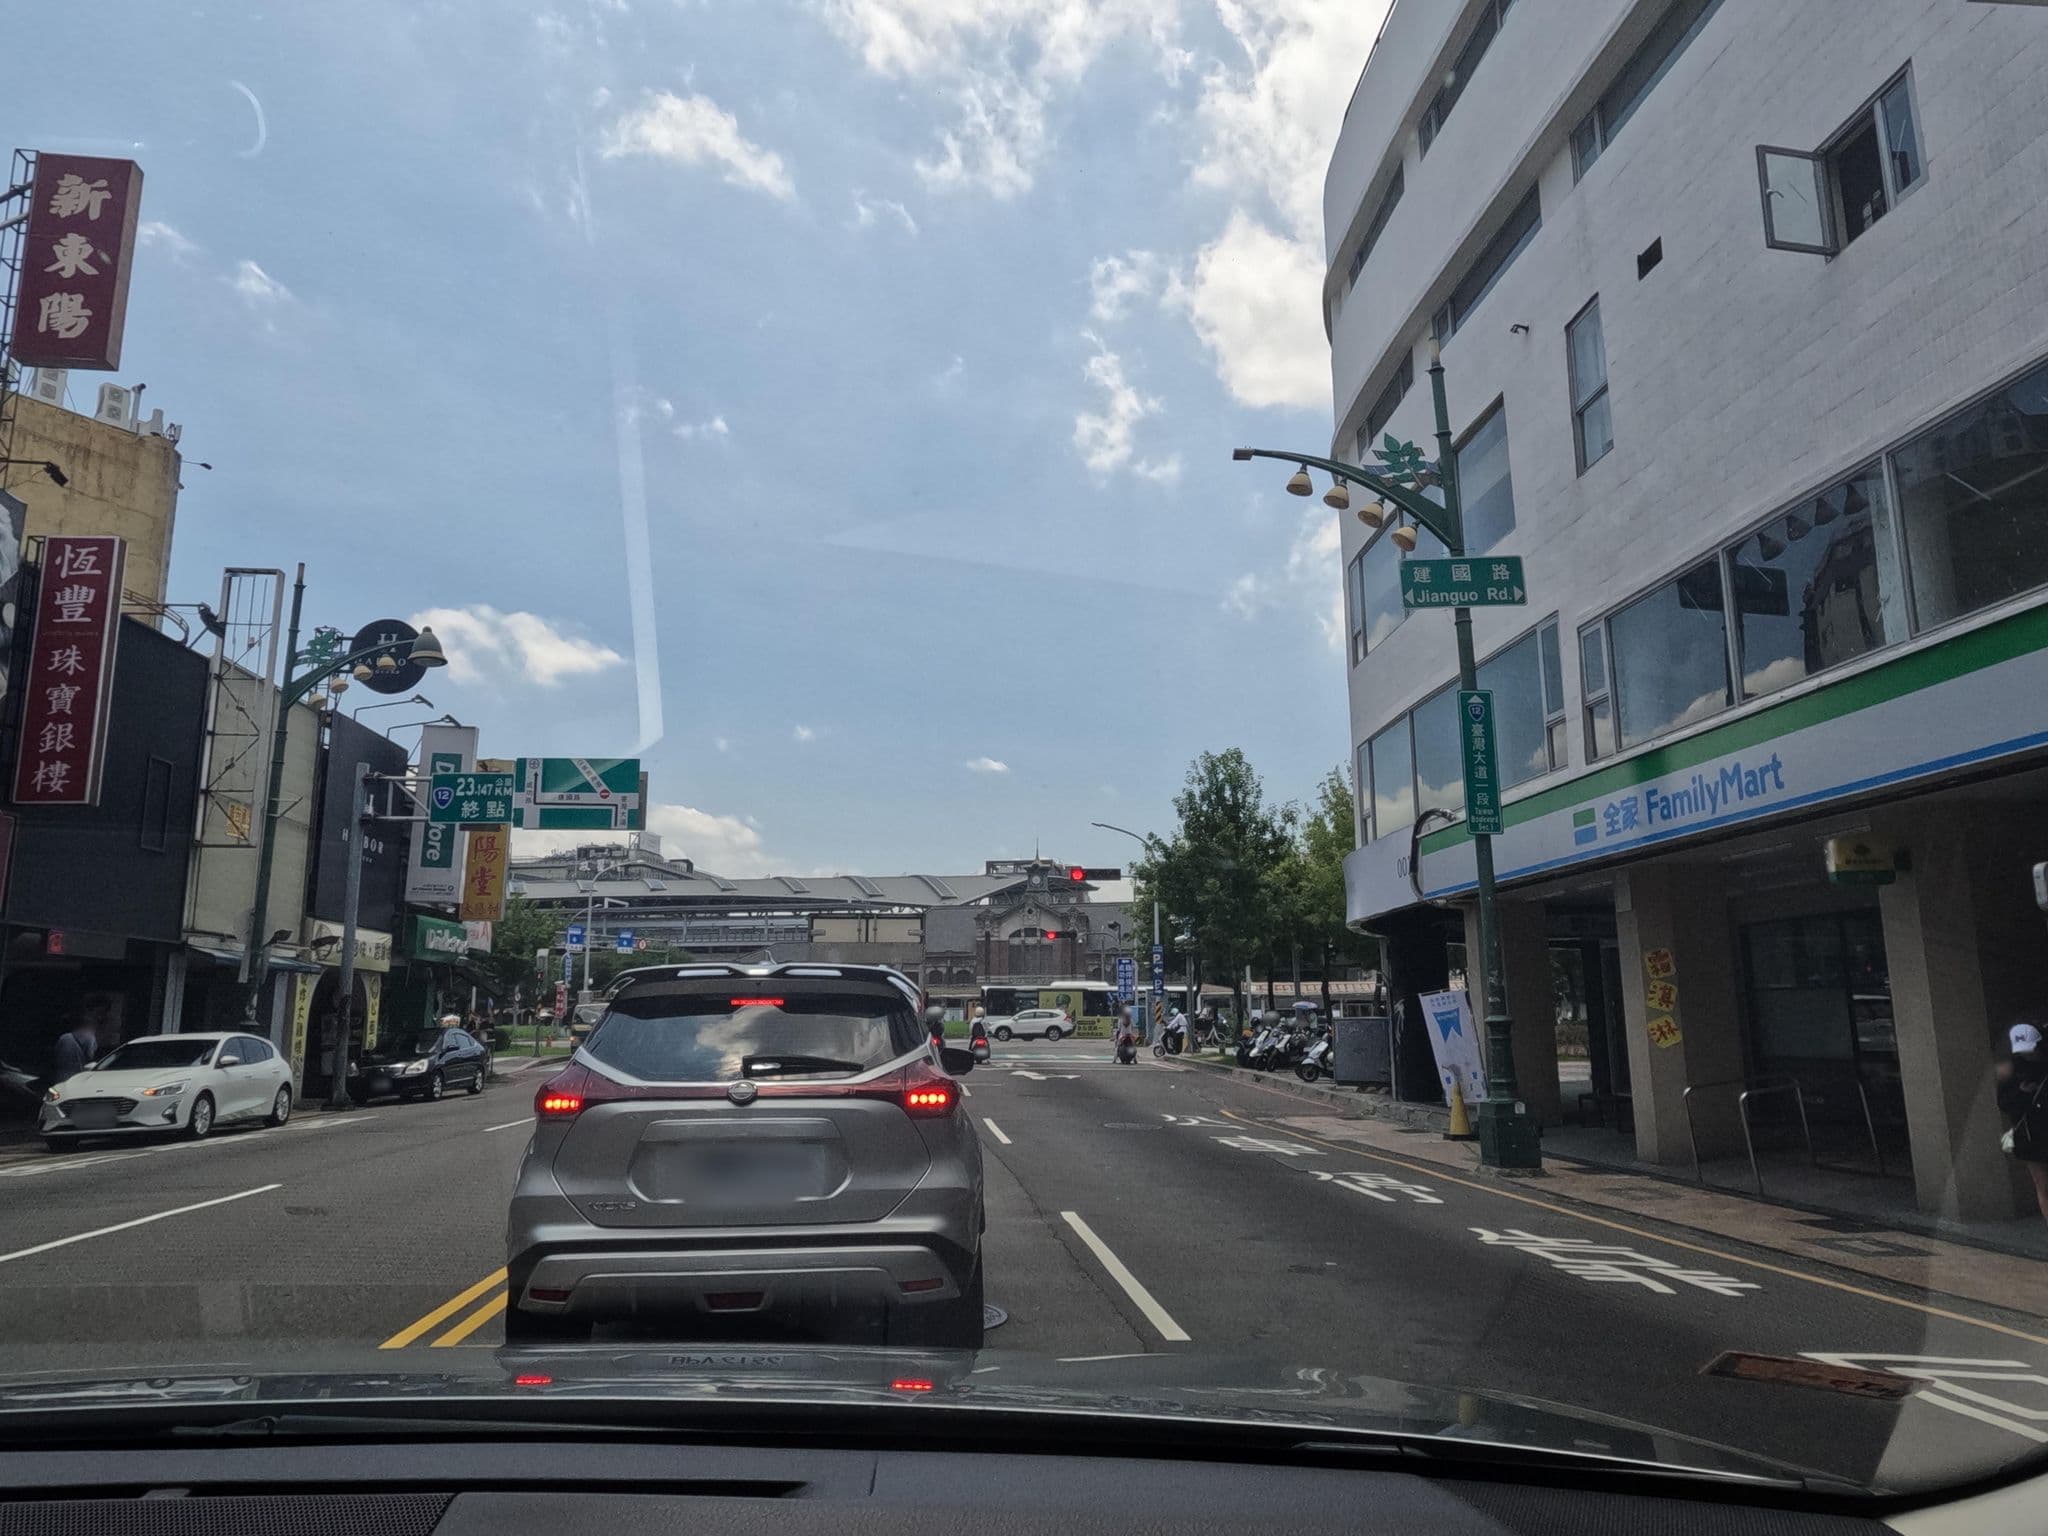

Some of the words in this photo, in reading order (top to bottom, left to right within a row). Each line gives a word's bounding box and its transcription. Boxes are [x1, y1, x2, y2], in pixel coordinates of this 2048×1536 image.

[37, 172, 114, 340] 新東陽
[1413, 562, 1511, 584] 建國路
[1416, 588, 1479, 605] Jianguo
[1486, 586, 1513, 601] Rd.
[1471, 706, 1482, 716] 12
[1470, 722, 1491, 807] 臺灣大道一段
[437, 790, 450, 801] 12
[455, 776, 494, 797] 23.147
[494, 787, 513, 797] KM
[1602, 795, 1639, 837] 全家
[1644, 753, 1786, 825] FamilyMart
[460, 800, 506, 819] 終點
